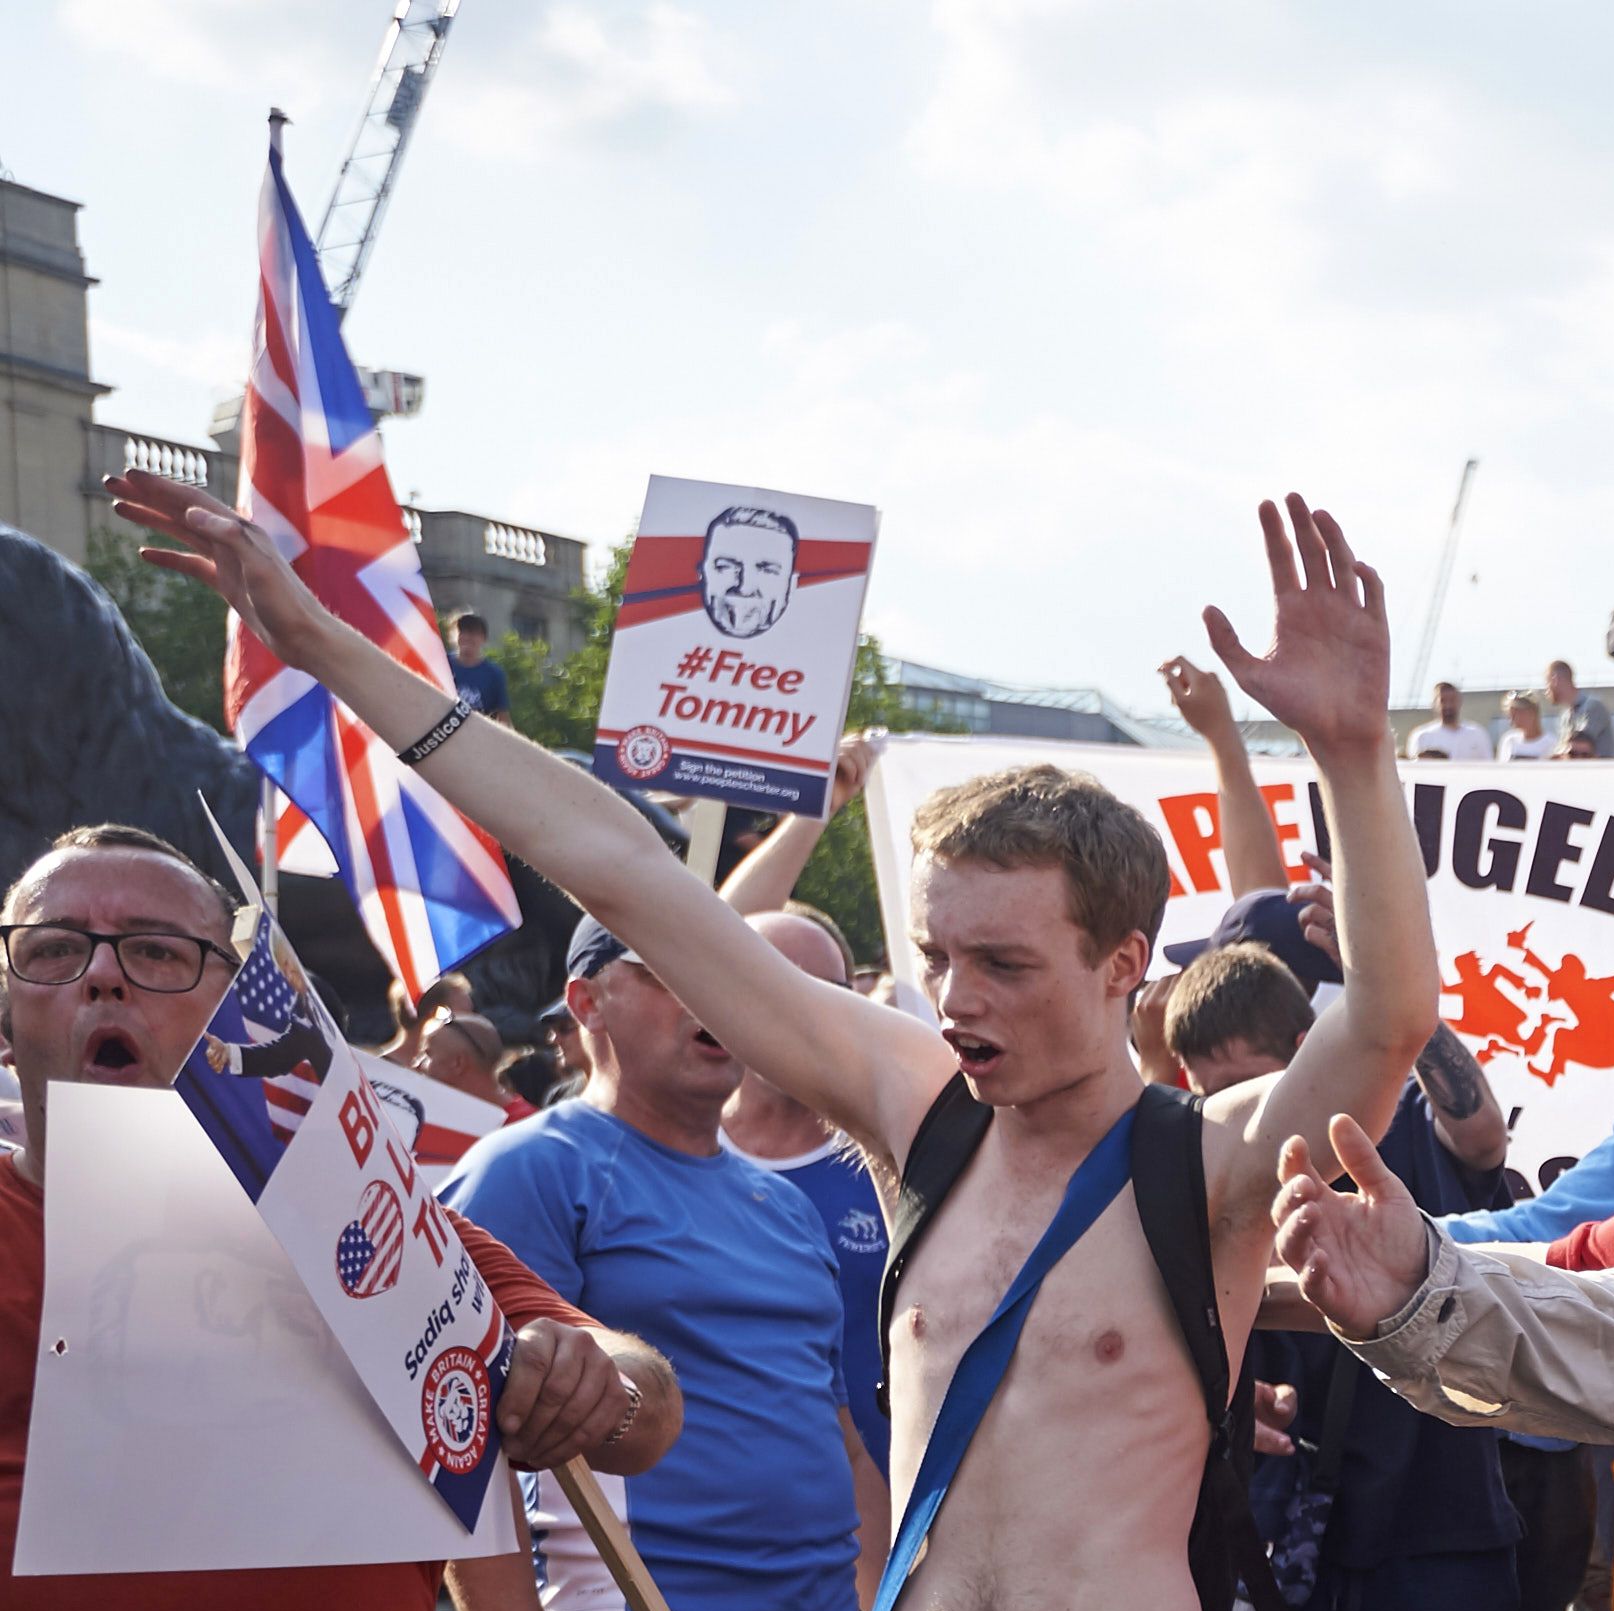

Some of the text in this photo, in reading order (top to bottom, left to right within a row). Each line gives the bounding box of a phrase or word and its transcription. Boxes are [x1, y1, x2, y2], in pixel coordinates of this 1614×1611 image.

[677, 646, 805, 694] #Free
[412, 717, 460, 760] Justice
[658, 683, 817, 747] Tommy
[404, 1299, 456, 1381] Sadiq
[425, 1352, 488, 1469] MAKE BRITAIN GREAT AGAIN
